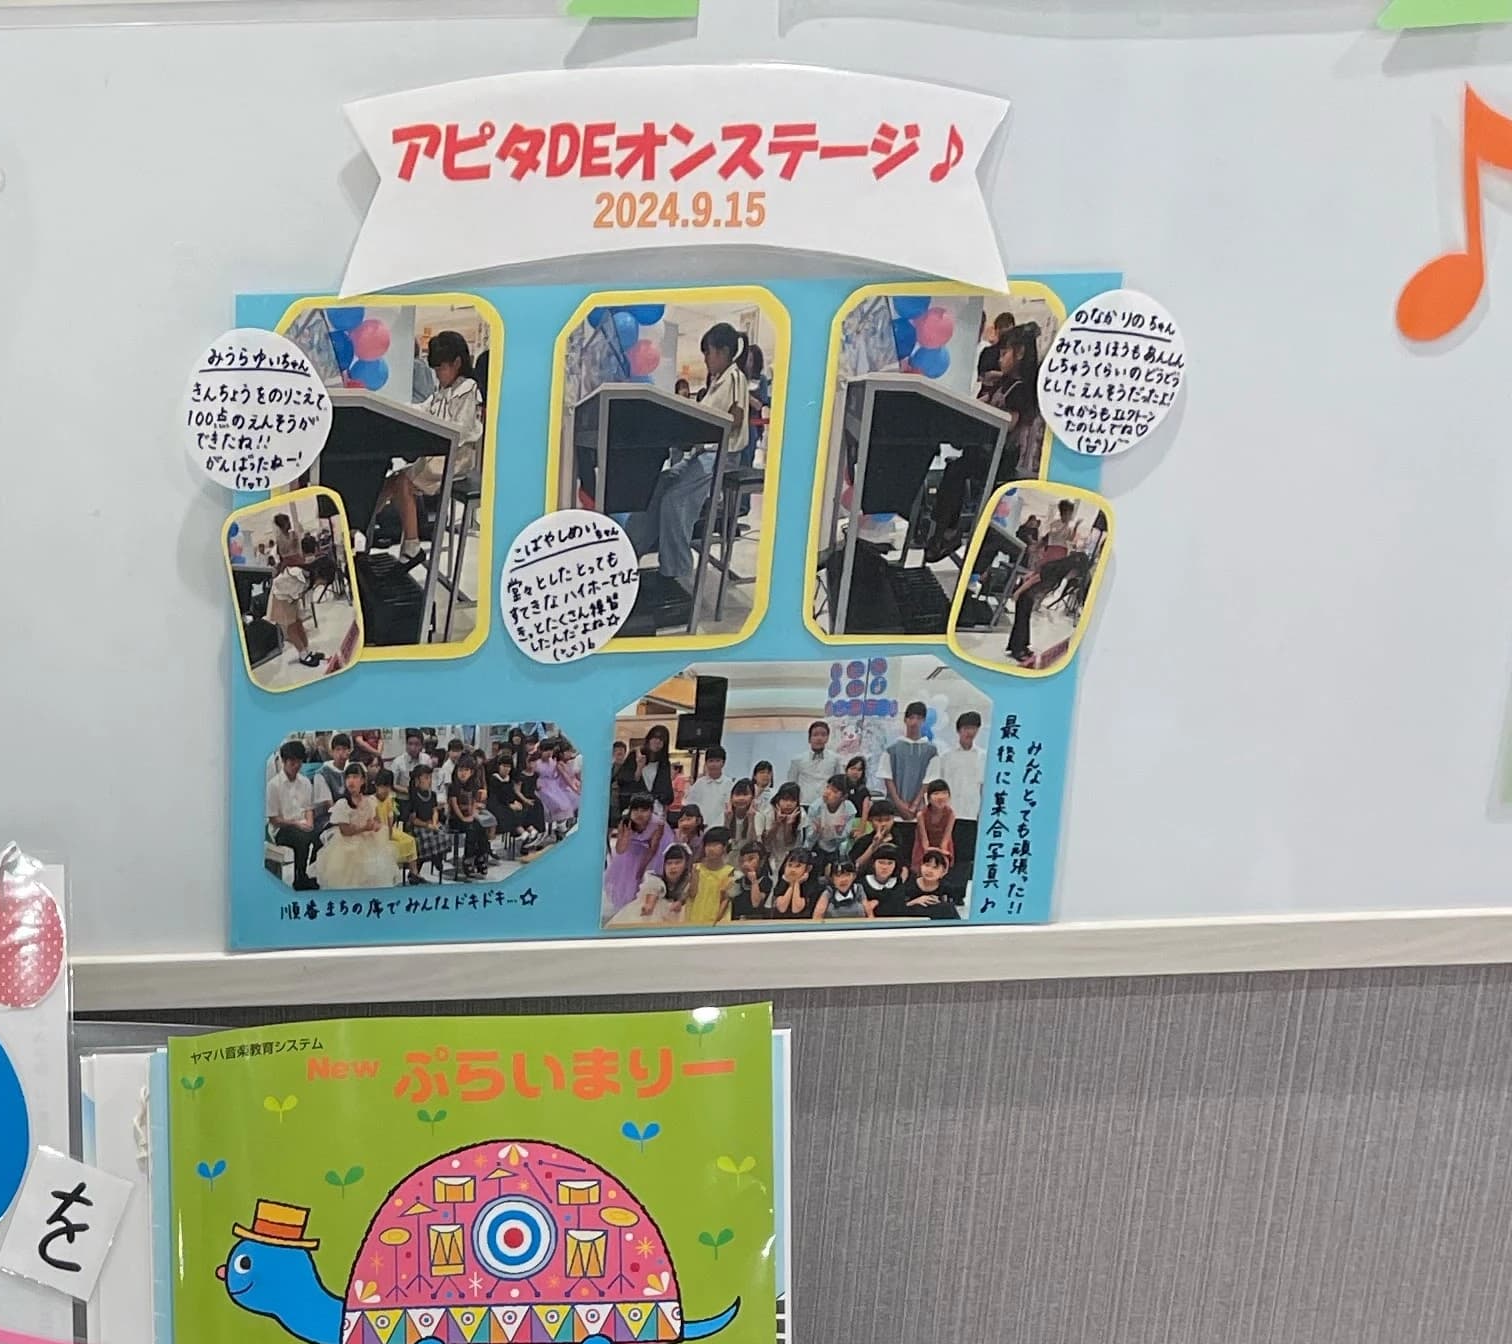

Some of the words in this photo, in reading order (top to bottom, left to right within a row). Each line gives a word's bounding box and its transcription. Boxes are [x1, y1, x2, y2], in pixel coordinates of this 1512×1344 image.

[593, 192, 766, 229] 2024.9.15
[190, 1037, 324, 1064] ヤマハ音楽教育システム
[307, 1056, 381, 1081] New
[394, 1045, 738, 1104] ぷらいまりー
